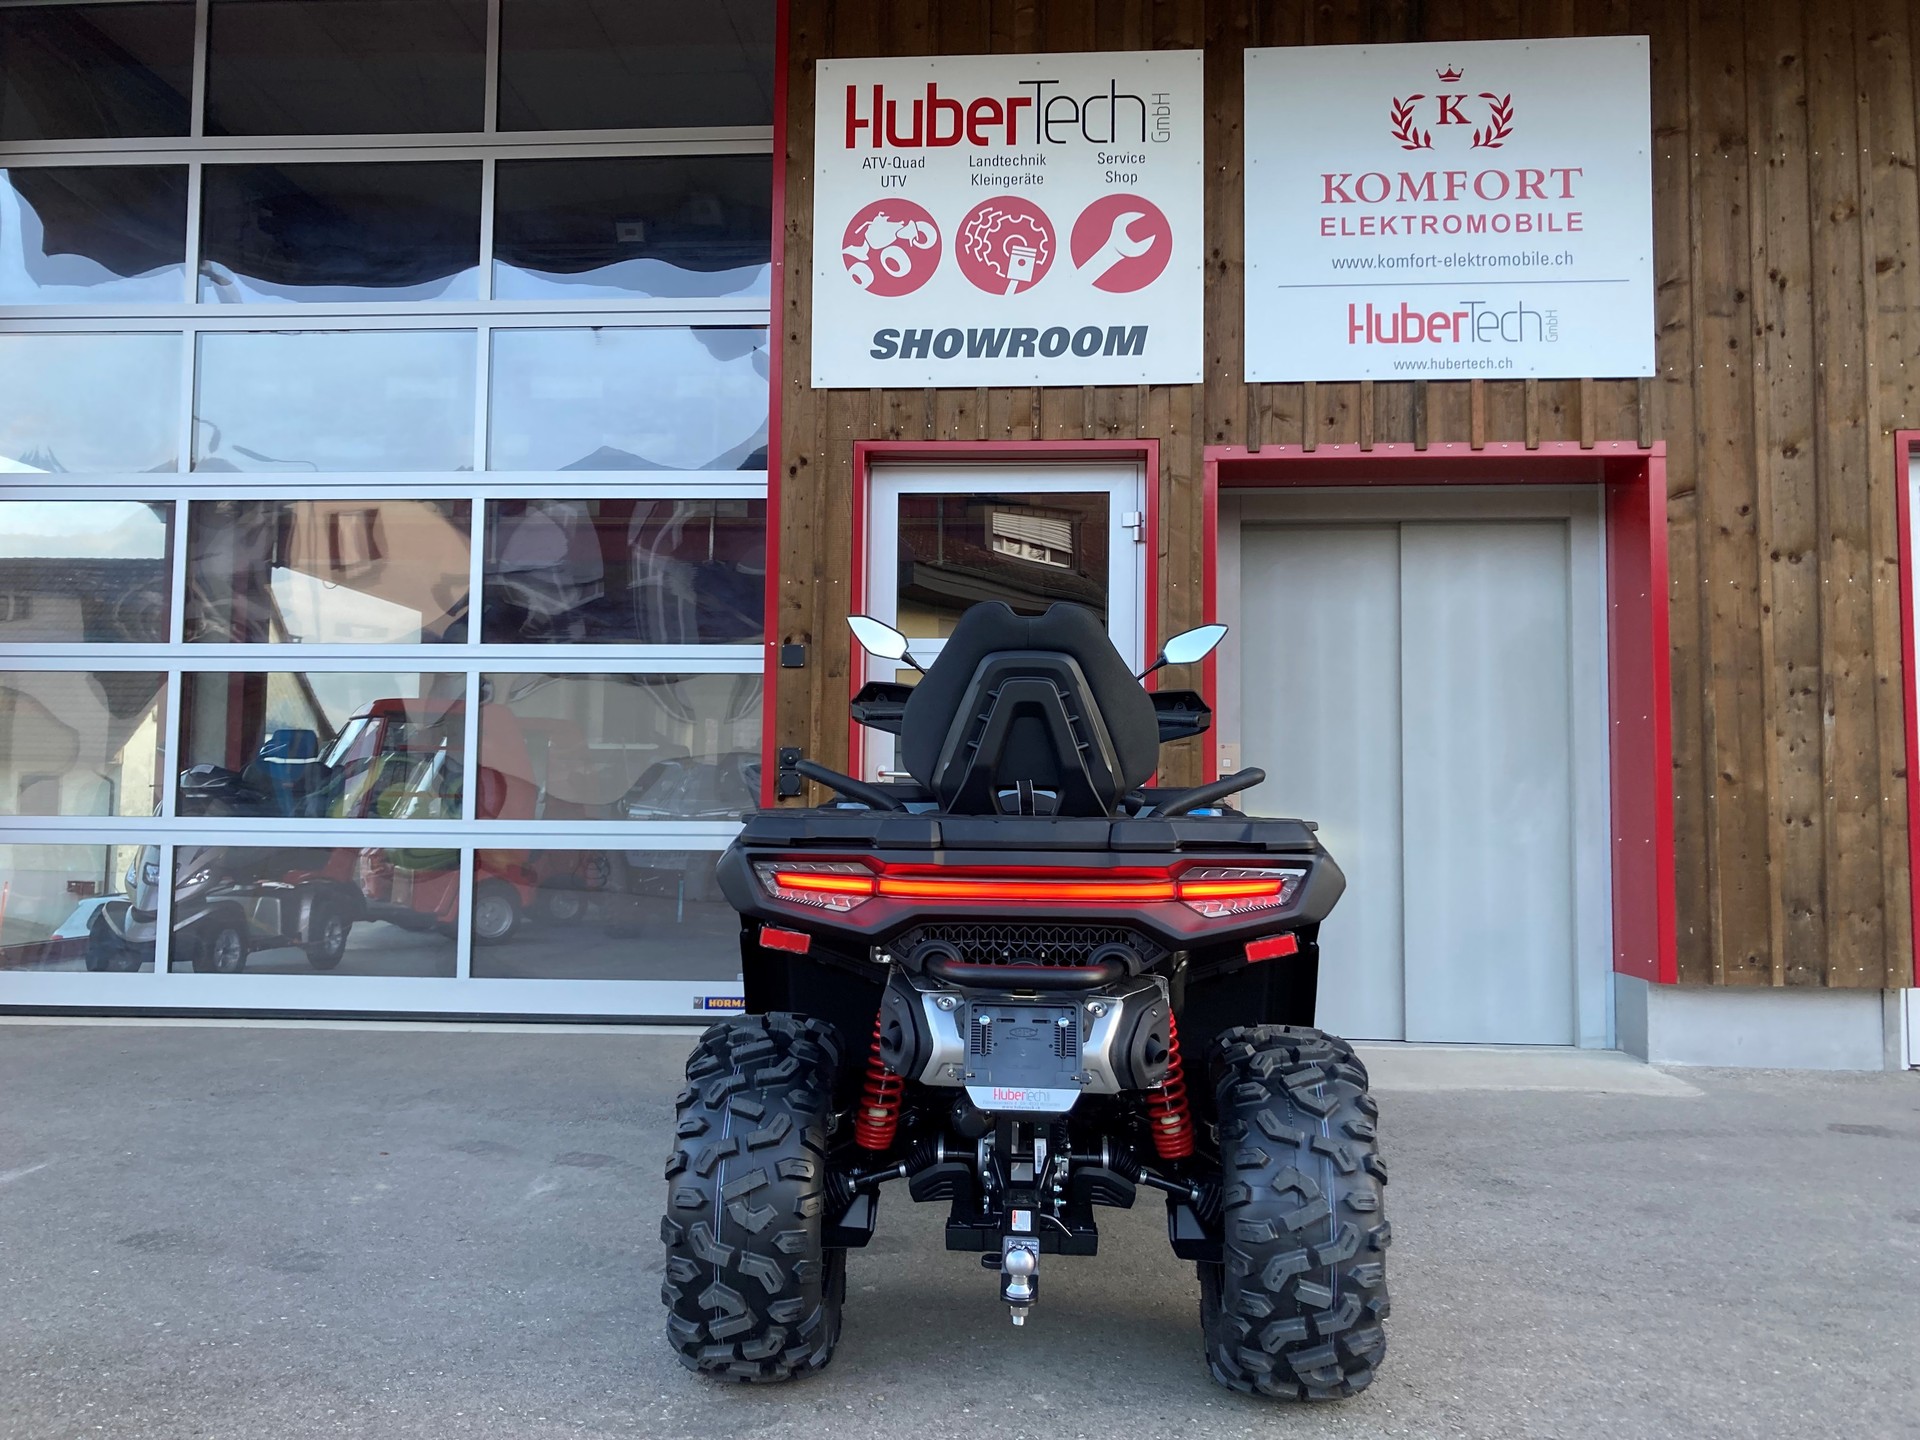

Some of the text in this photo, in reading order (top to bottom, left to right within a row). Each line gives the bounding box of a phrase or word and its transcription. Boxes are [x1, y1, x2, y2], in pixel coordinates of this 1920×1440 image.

[845, 78, 1146, 149] HuberTech
[1150, 92, 1171, 143] GmbH
[1435, 94, 1472, 125] K
[862, 155, 926, 170] ATV-Quad
[968, 153, 1047, 168] Landtechnik
[1097, 151, 1146, 165] Service
[880, 174, 907, 188] UTV
[970, 172, 1045, 188] Kleingeräte
[1105, 170, 1138, 185] Shop
[1320, 167, 1584, 204] KOMFORT
[1320, 211, 1584, 237] ELEKTROMOBILE
[1331, 250, 1574, 271] www.komfort-elektromobile.ch
[1348, 300, 1543, 345] HuberTech
[1545, 309, 1559, 343] GmbH
[869, 325, 1149, 360] SHOWROOM
[1393, 356, 1513, 371] www.hubertech.ch
